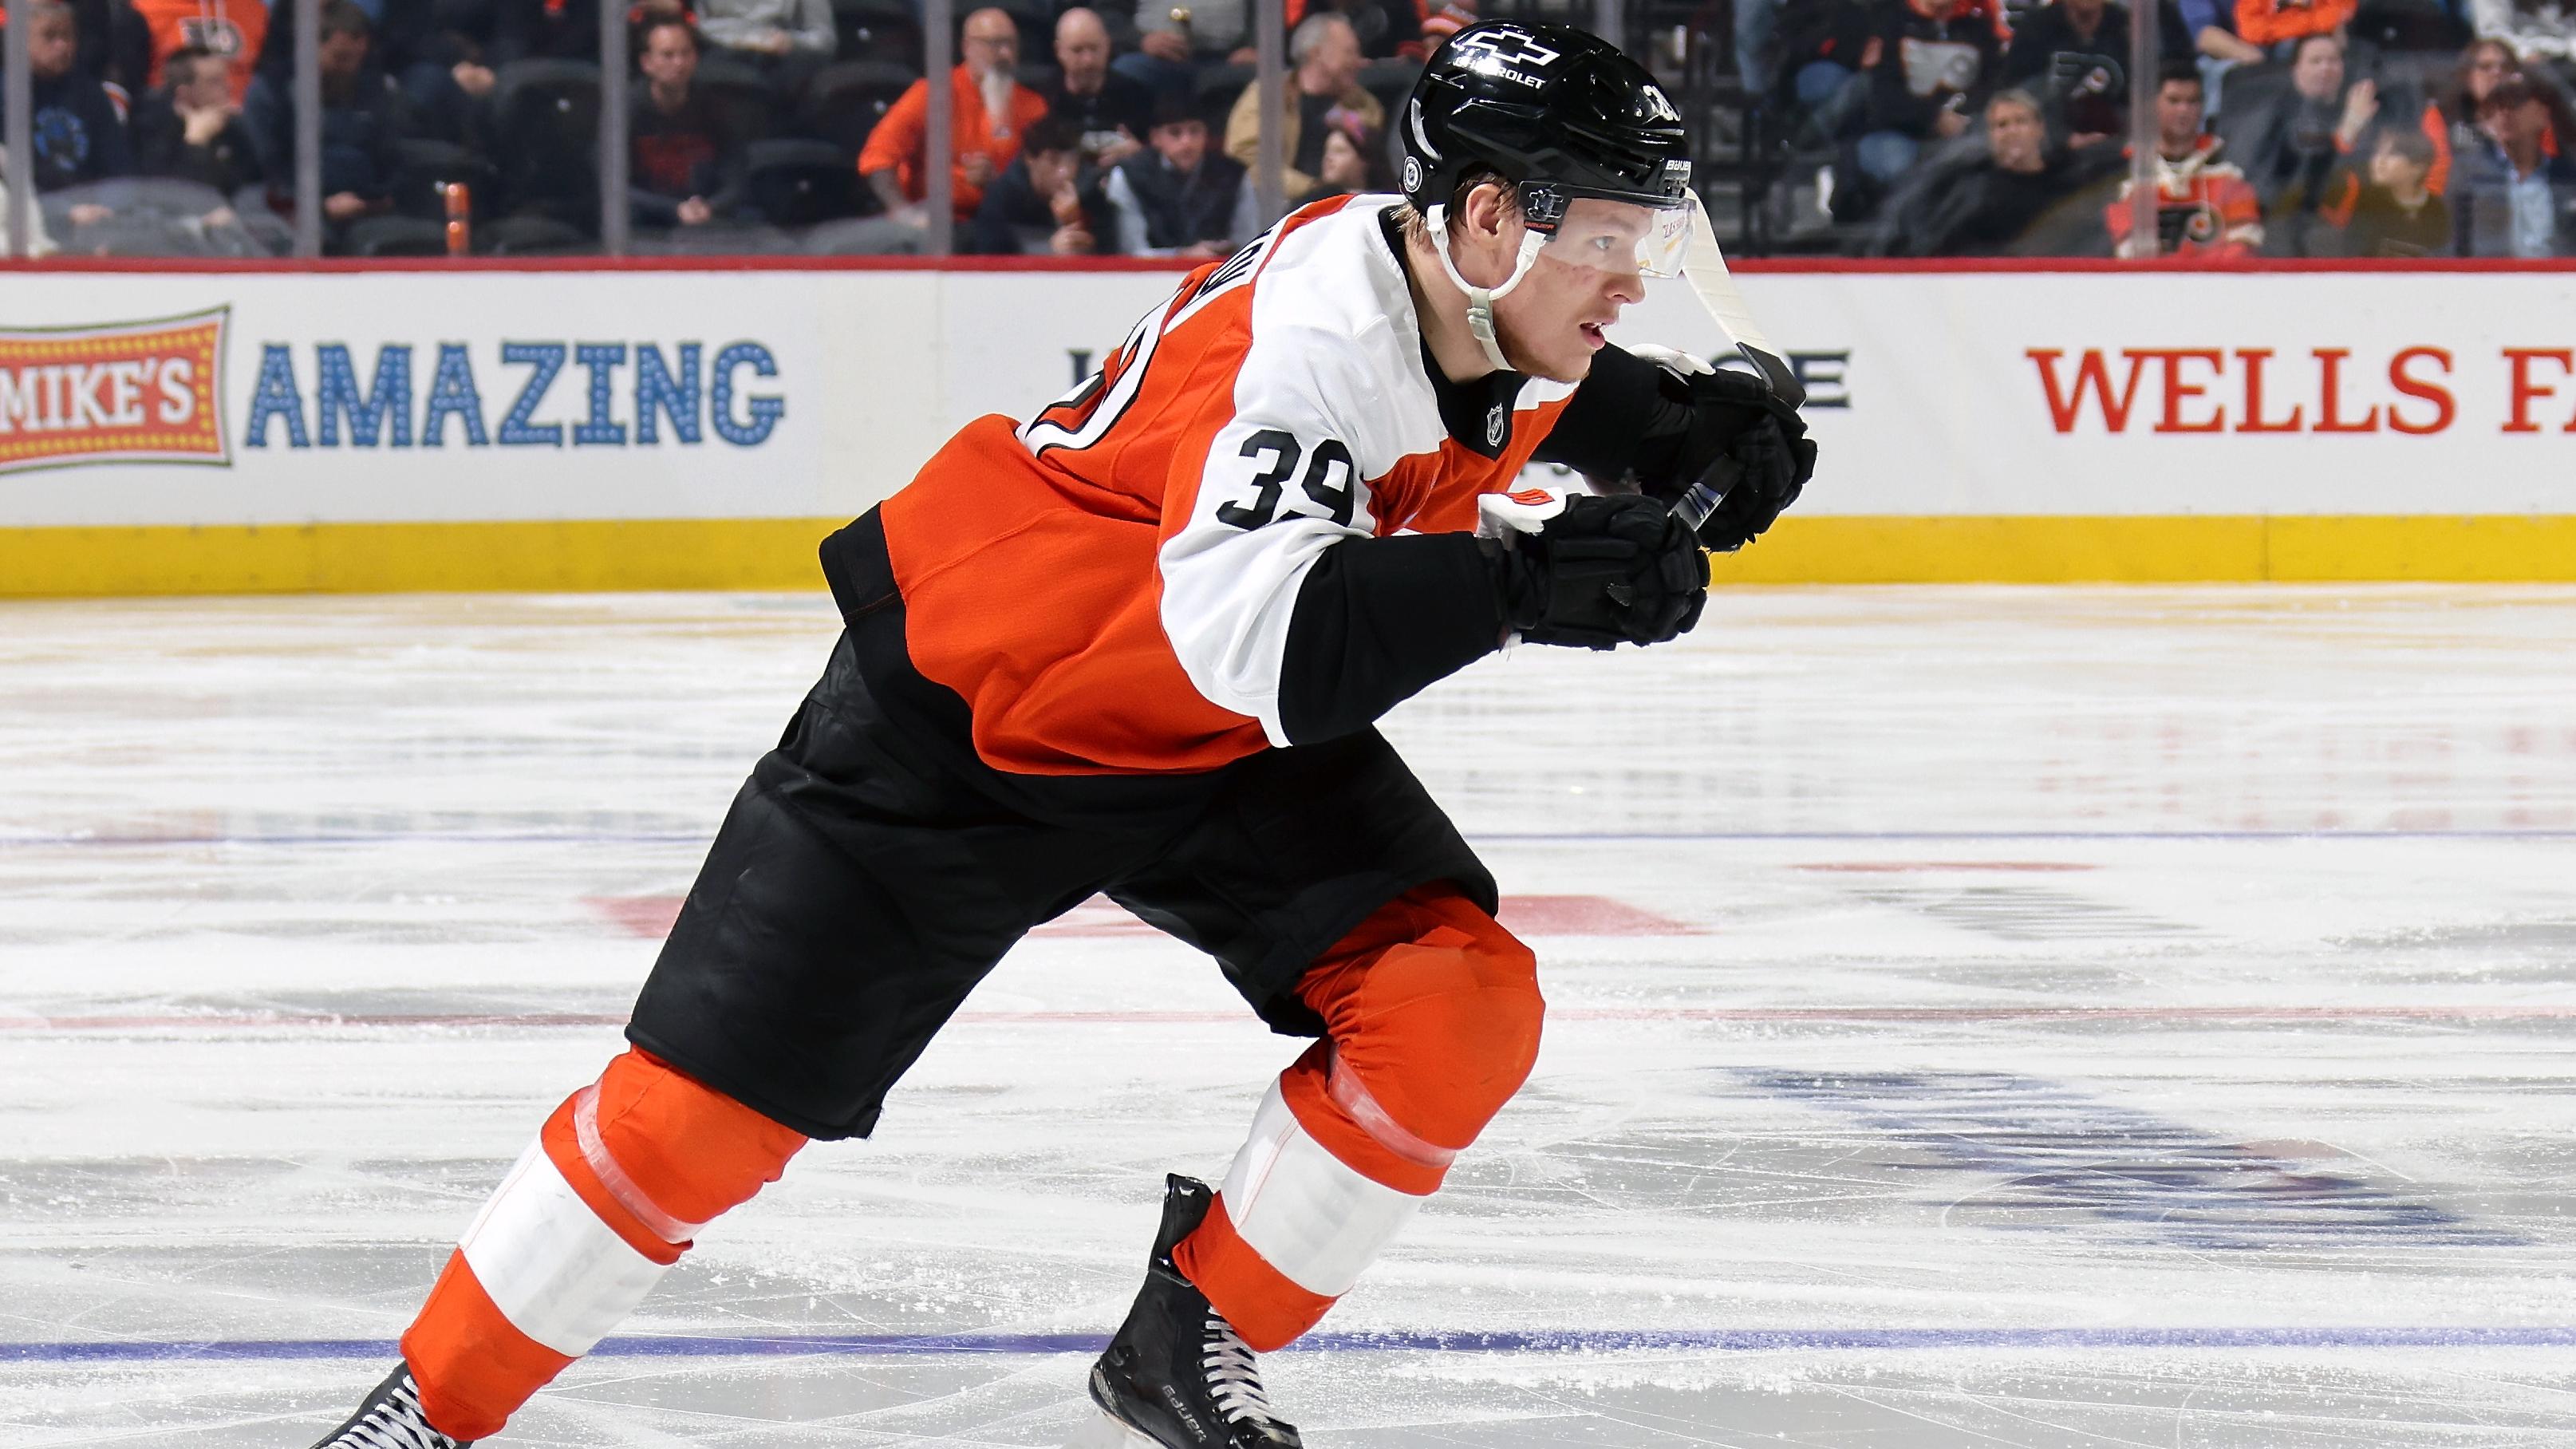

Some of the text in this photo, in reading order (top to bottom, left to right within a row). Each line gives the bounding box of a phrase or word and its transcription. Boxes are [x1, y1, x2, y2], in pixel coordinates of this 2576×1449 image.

[1665, 160, 1692, 172] BAUE
[0, 357, 195, 433] MIKE'S
[245, 341, 785, 448] AMAZING
[2026, 348, 2576, 434] WELLS F
[1217, 429, 1355, 531] 39
